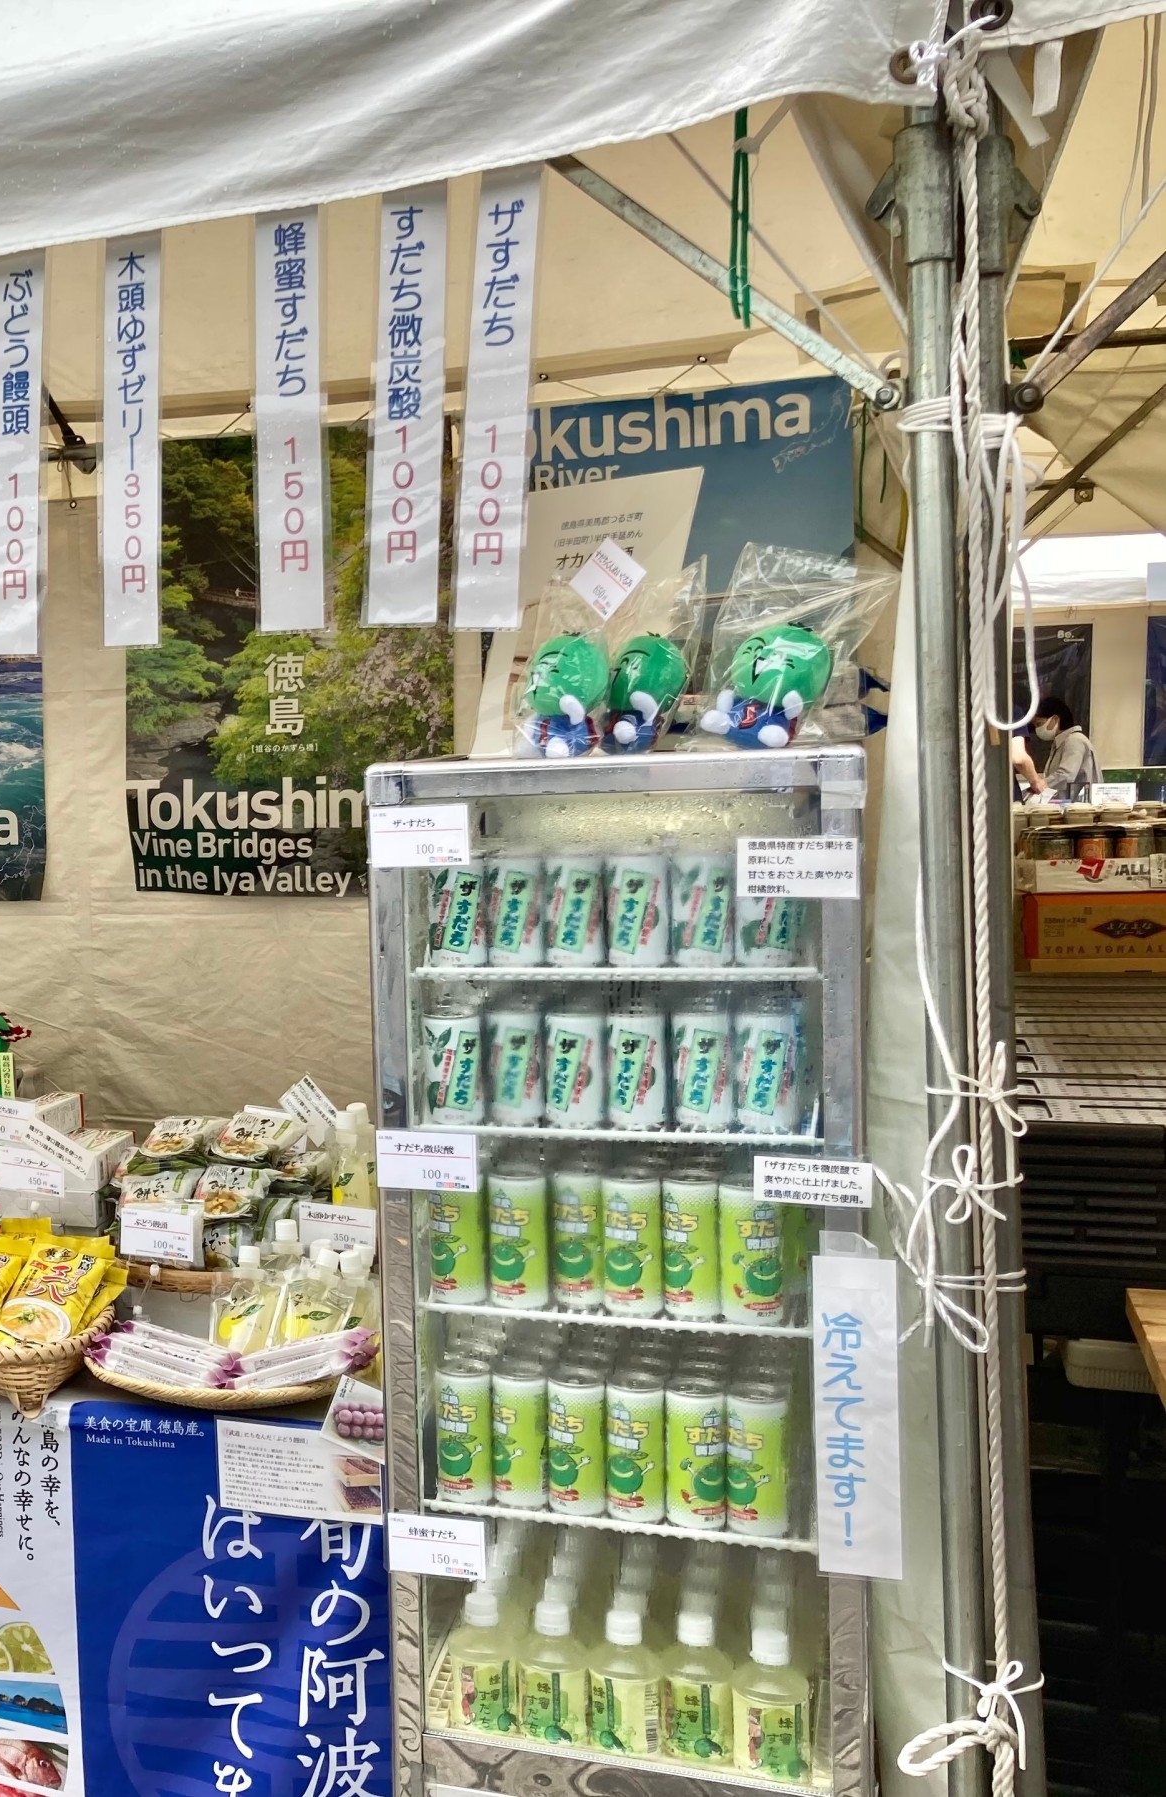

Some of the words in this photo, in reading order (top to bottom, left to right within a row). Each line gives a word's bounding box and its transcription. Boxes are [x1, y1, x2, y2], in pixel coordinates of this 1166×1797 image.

[482, 199, 525, 347] ザすだち
[273, 221, 307, 398] 蜂蜜すだち
[387, 205, 425, 421] すだち微炭酸
[1, 269, 32, 437] ぶどう饅頭
[117, 251, 146, 471] 木頭ゆずゼリー
[524, 392, 811, 463] kushima
[386, 425, 417, 564] 100円
[473, 424, 503, 566] 100円
[534, 464, 621, 491] River
[280, 436, 309, 574] 150円
[3, 473, 28, 600] 100円
[122, 473, 146, 595] 350円
[263, 652, 307, 737] 徳島
[126, 776, 365, 831] Tokushim
[392, 818, 436, 829] ザ・すだち
[132, 831, 192, 859] Vine
[197, 831, 313, 864] Bridges
[748, 841, 854, 851] 徳島県特産すだち果汁を
[748, 856, 794, 865] 原料にした
[138, 863, 162, 889] in
[165, 865, 208, 892] the
[213, 865, 255, 896] Iya
[258, 865, 352, 897] Valley
[747, 885, 791, 895] 柑橘飲料。
[748, 870, 854, 880] 甘さをおさえた爽やかな
[449, 880, 478, 946] ザすだち
[1044, 945, 1085, 954] YONA
[1095, 945, 1135, 954] YONA
[453, 1038, 477, 1105] ザすだち
[394, 1142, 454, 1154] すだち微炭酸
[763, 1160, 860, 1175] 「ザすだち」を微炭酸で
[764, 1175, 864, 1190] 爽やかに仕上げました。
[764, 1190, 865, 1205] 徳島県産のすだち使用。
[134, 1218, 168, 1230] ぶどう饅頭
[83, 1416, 206, 1437] 美食の宝庫、徳島産。
[86, 1434, 111, 1446] Made
[113, 1435, 123, 1446] in
[125, 1436, 176, 1449] Tokushima
[821, 1311, 865, 1546] 冷えてます!
[408, 1526, 456, 1540] 蜂蜜すだち
[296, 1520, 384, 1797] 旬の阿波
